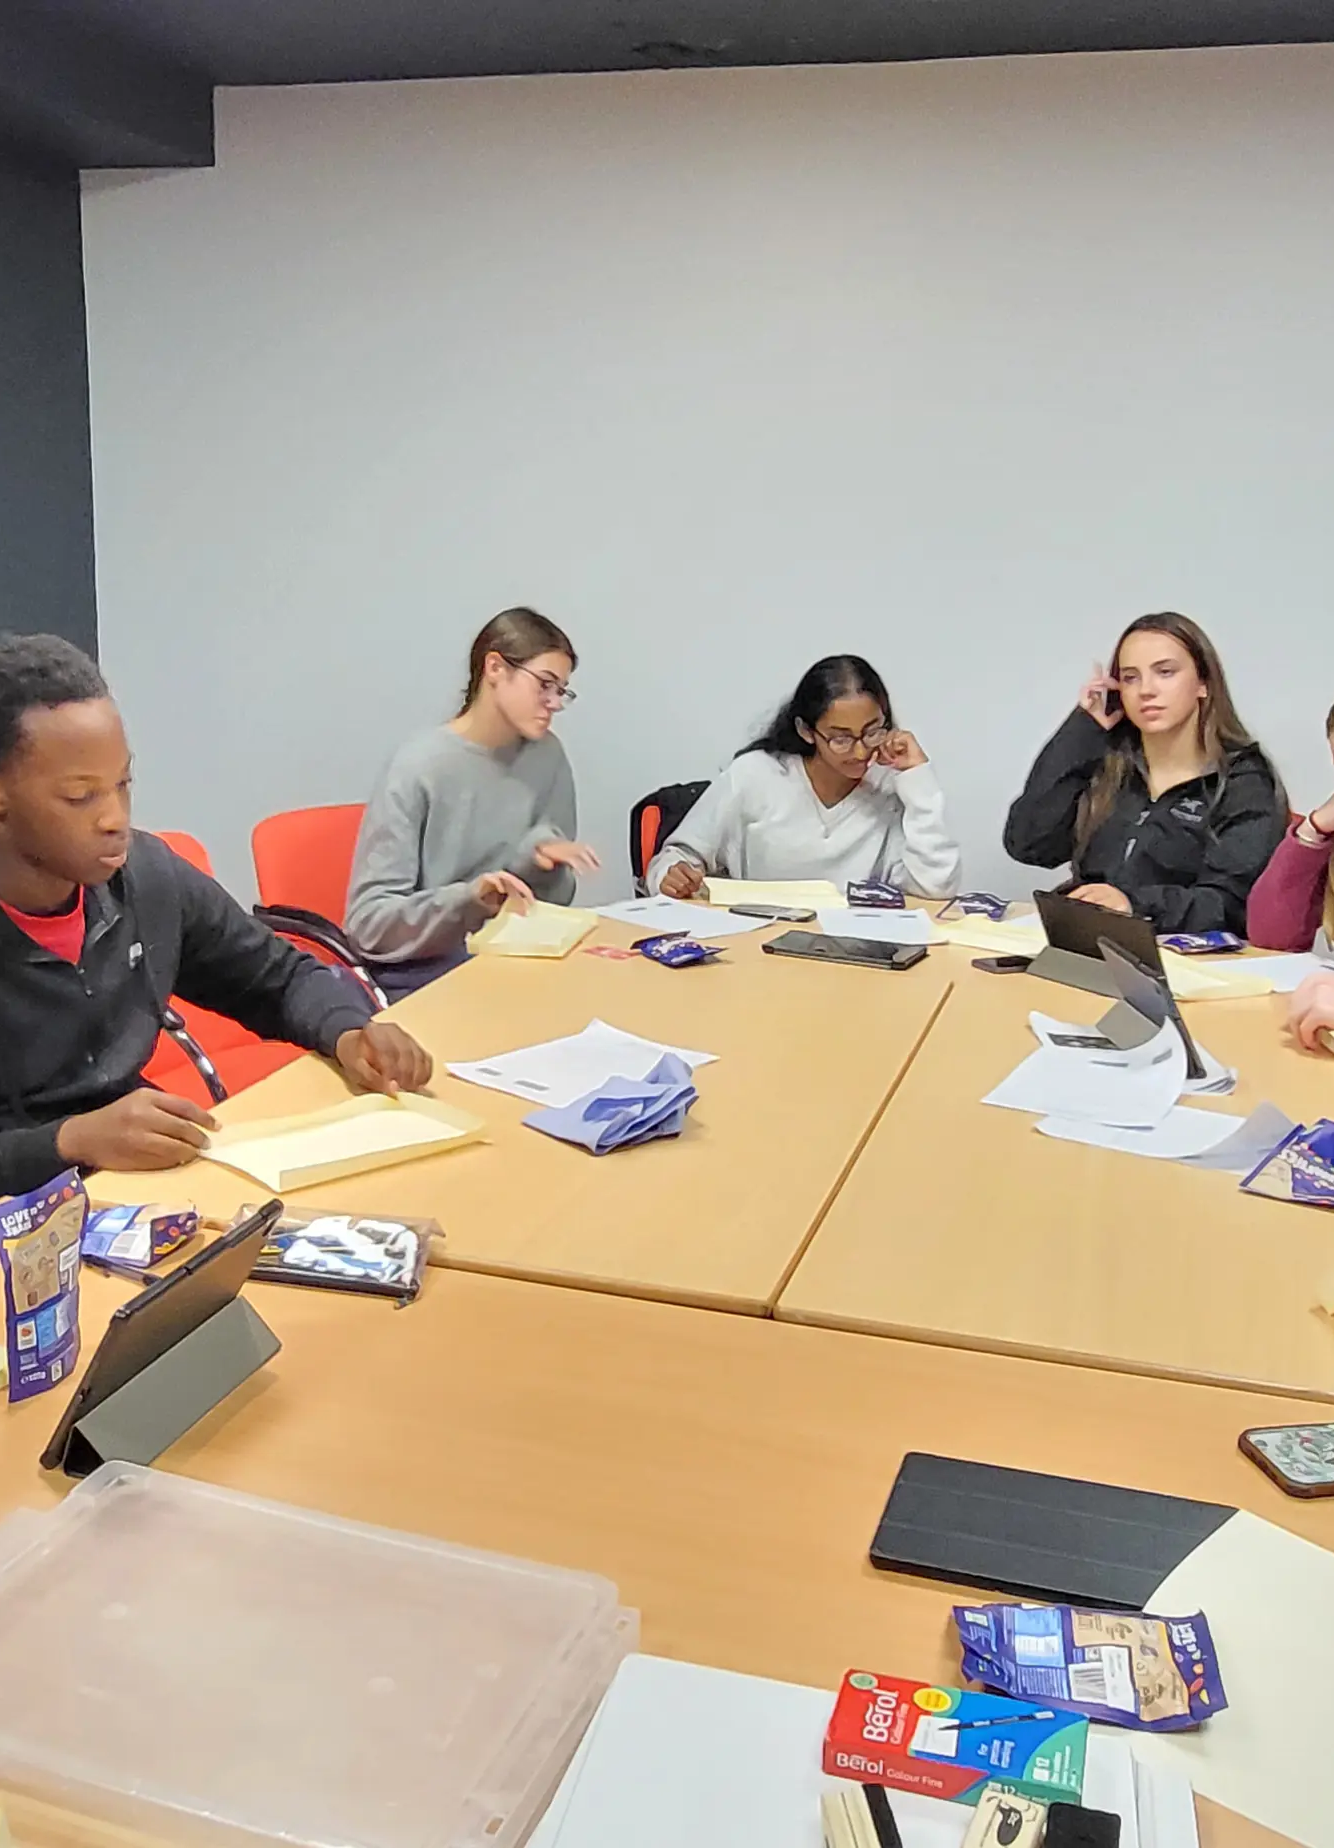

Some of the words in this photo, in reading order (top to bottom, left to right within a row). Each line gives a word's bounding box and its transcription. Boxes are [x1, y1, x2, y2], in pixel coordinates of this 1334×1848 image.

[863, 1688, 899, 1743] Berol
[836, 1752, 884, 1776] Berol
[887, 1768, 920, 1783] Colour
[922, 1775, 943, 1789] Fine
